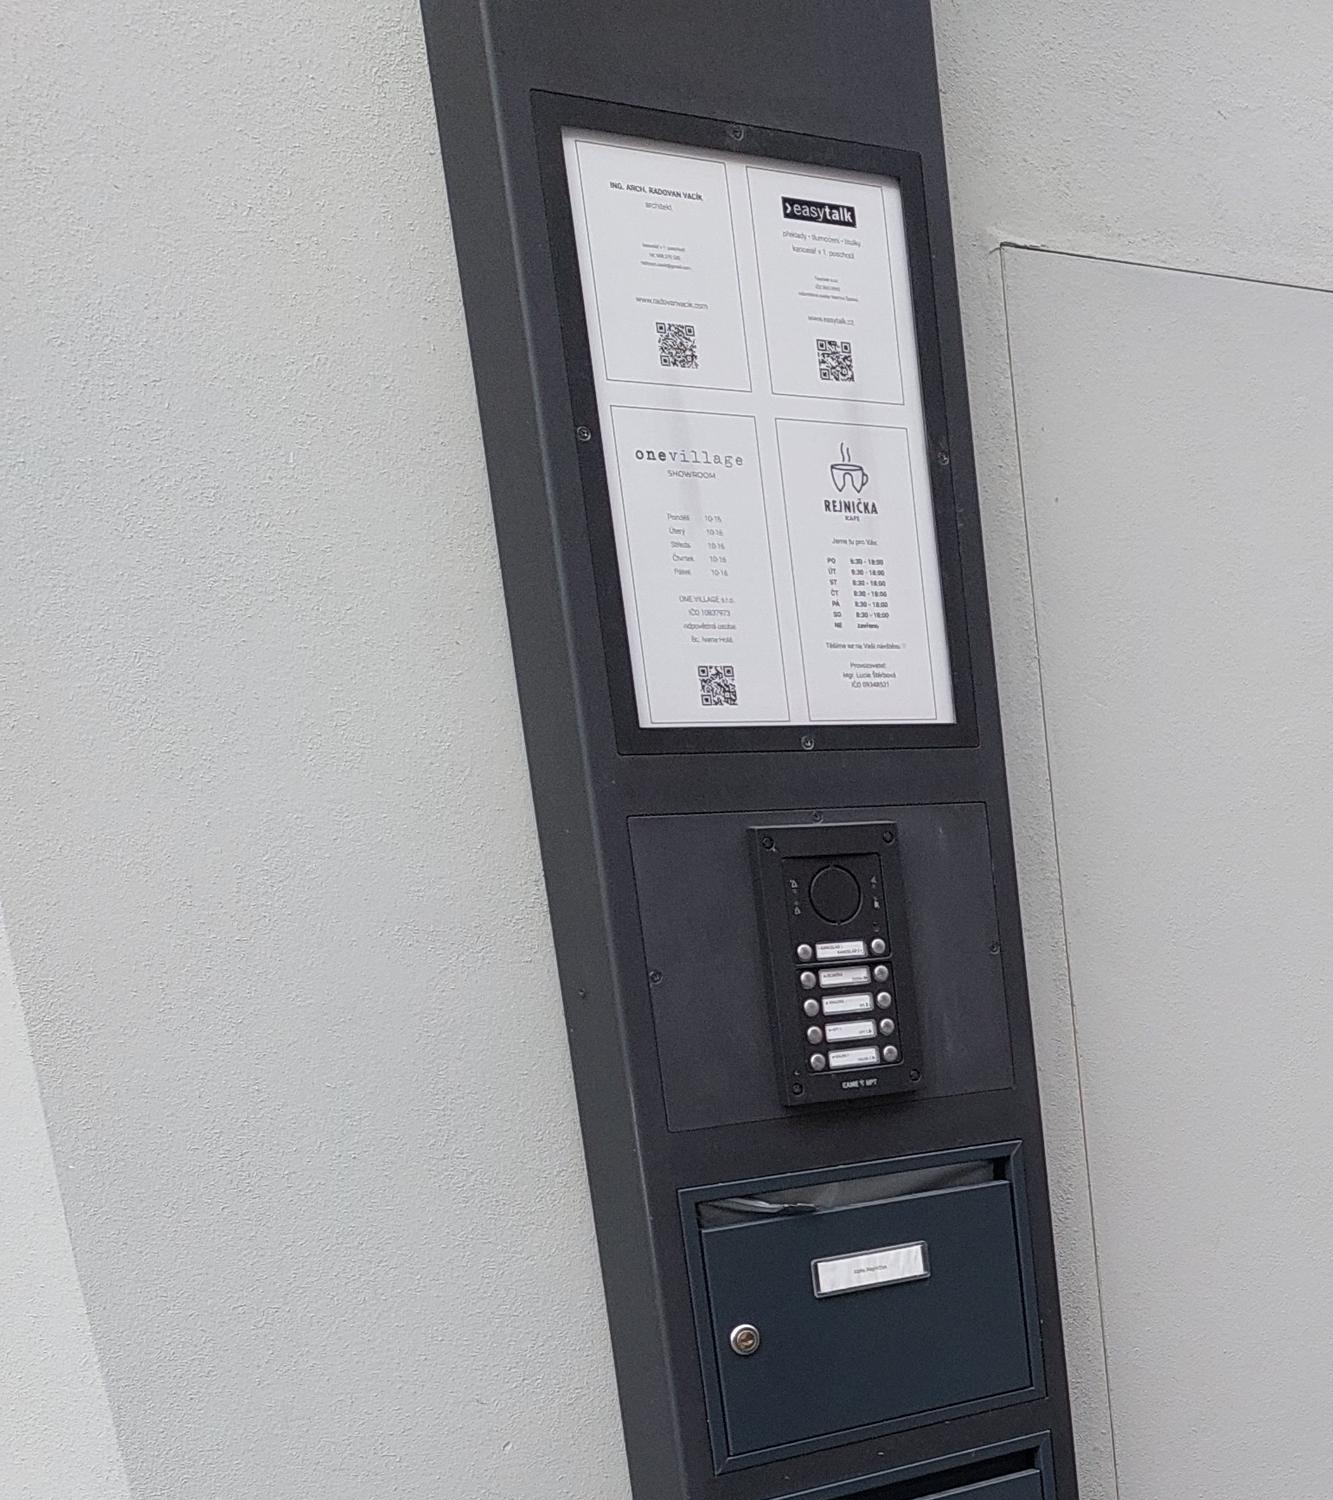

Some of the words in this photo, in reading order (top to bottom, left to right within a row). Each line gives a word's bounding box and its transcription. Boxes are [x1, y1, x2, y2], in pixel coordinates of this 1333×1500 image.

[635, 449, 744, 468] onevillage
[667, 469, 716, 479] SHOWROOM
[824, 498, 878, 514] REJNIČKA
